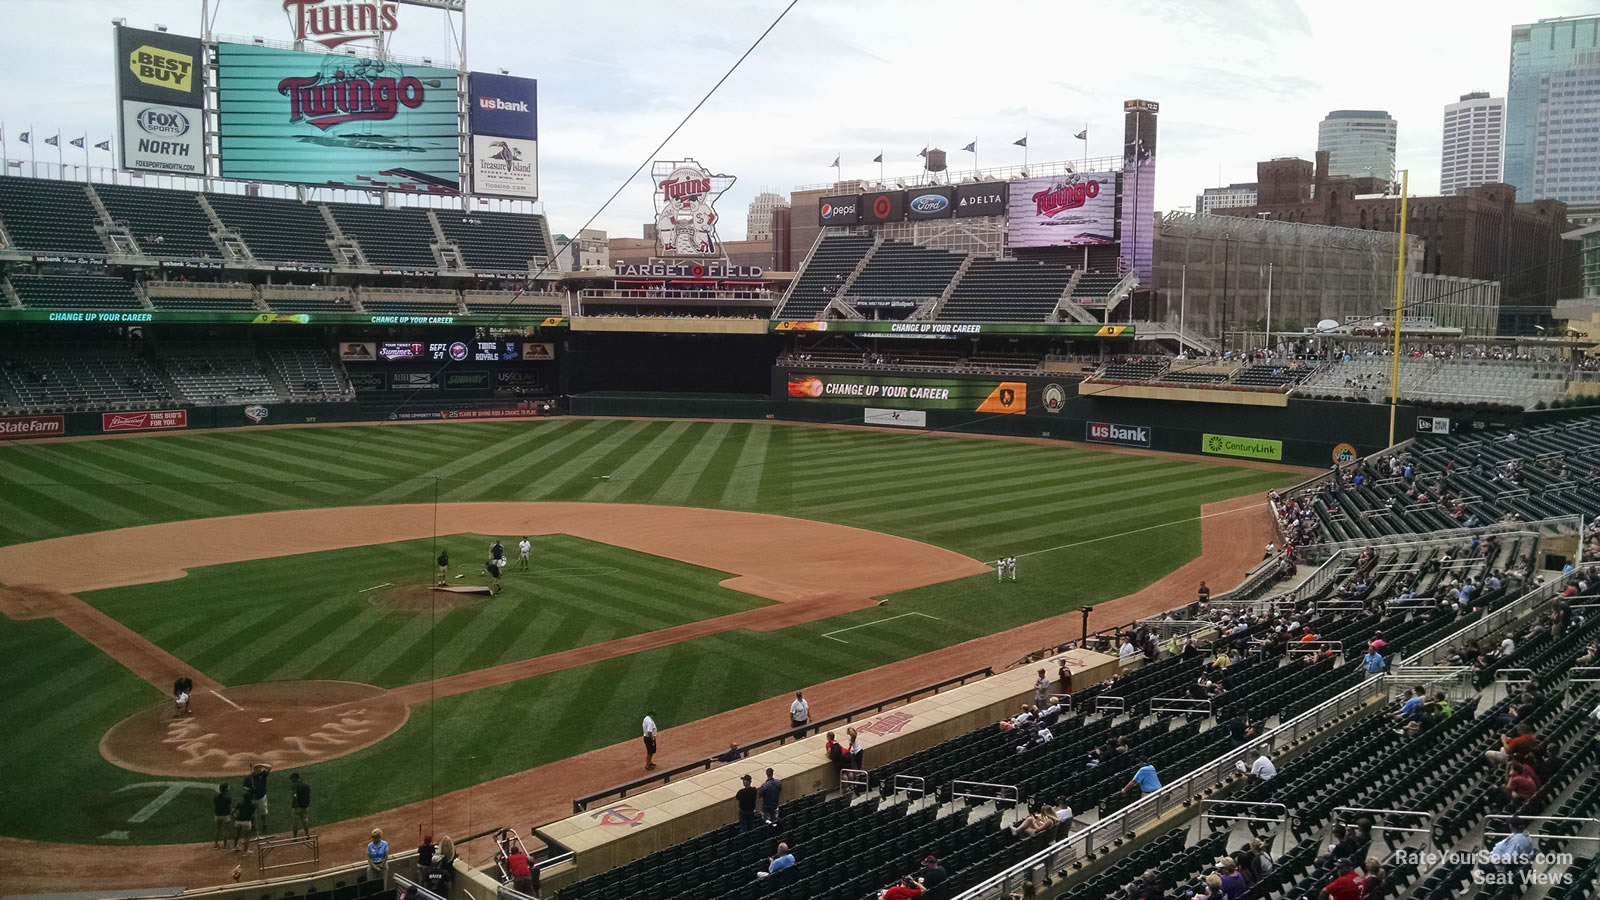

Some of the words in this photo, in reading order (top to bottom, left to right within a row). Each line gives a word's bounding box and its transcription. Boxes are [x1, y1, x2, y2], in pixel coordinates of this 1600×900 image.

[284, 0, 398, 47] Twins
[138, 52, 191, 73] BEST
[140, 65, 186, 84] BUY
[278, 71, 424, 130] Twingo
[480, 98, 530, 112] usbank
[148, 112, 178, 128] FOX
[148, 125, 180, 133] SPORTS
[138, 138, 190, 156] NORTH
[136, 160, 195, 171] FOXSPORTSNORTH.COM
[480, 159, 506, 170] Treasure
[512, 162, 531, 173] Island
[659, 176, 710, 202] Twins
[917, 200, 940, 210] Ford
[970, 194, 1001, 205] DELTA
[1032, 180, 1099, 217] Twingo
[833, 204, 856, 216] pepsi
[616, 264, 689, 276] TARGET
[708, 266, 762, 277] FIELD
[49, 313, 83, 321] CHANGE
[85, 313, 96, 321] UP
[99, 313, 120, 321] YOUR
[122, 313, 152, 321] CAREER
[892, 324, 920, 332] CHANGE
[380, 348, 414, 357] Summer
[448, 375, 486, 384] SUBWAY
[826, 383, 863, 396] CHANGE
[865, 385, 879, 396] UP
[882, 386, 907, 398] YOUR
[910, 388, 949, 400] CAREER
[1091, 425, 1147, 441] usbank
[1225, 441, 1275, 454] CenturyLink
[856, 712, 914, 736] Twins
